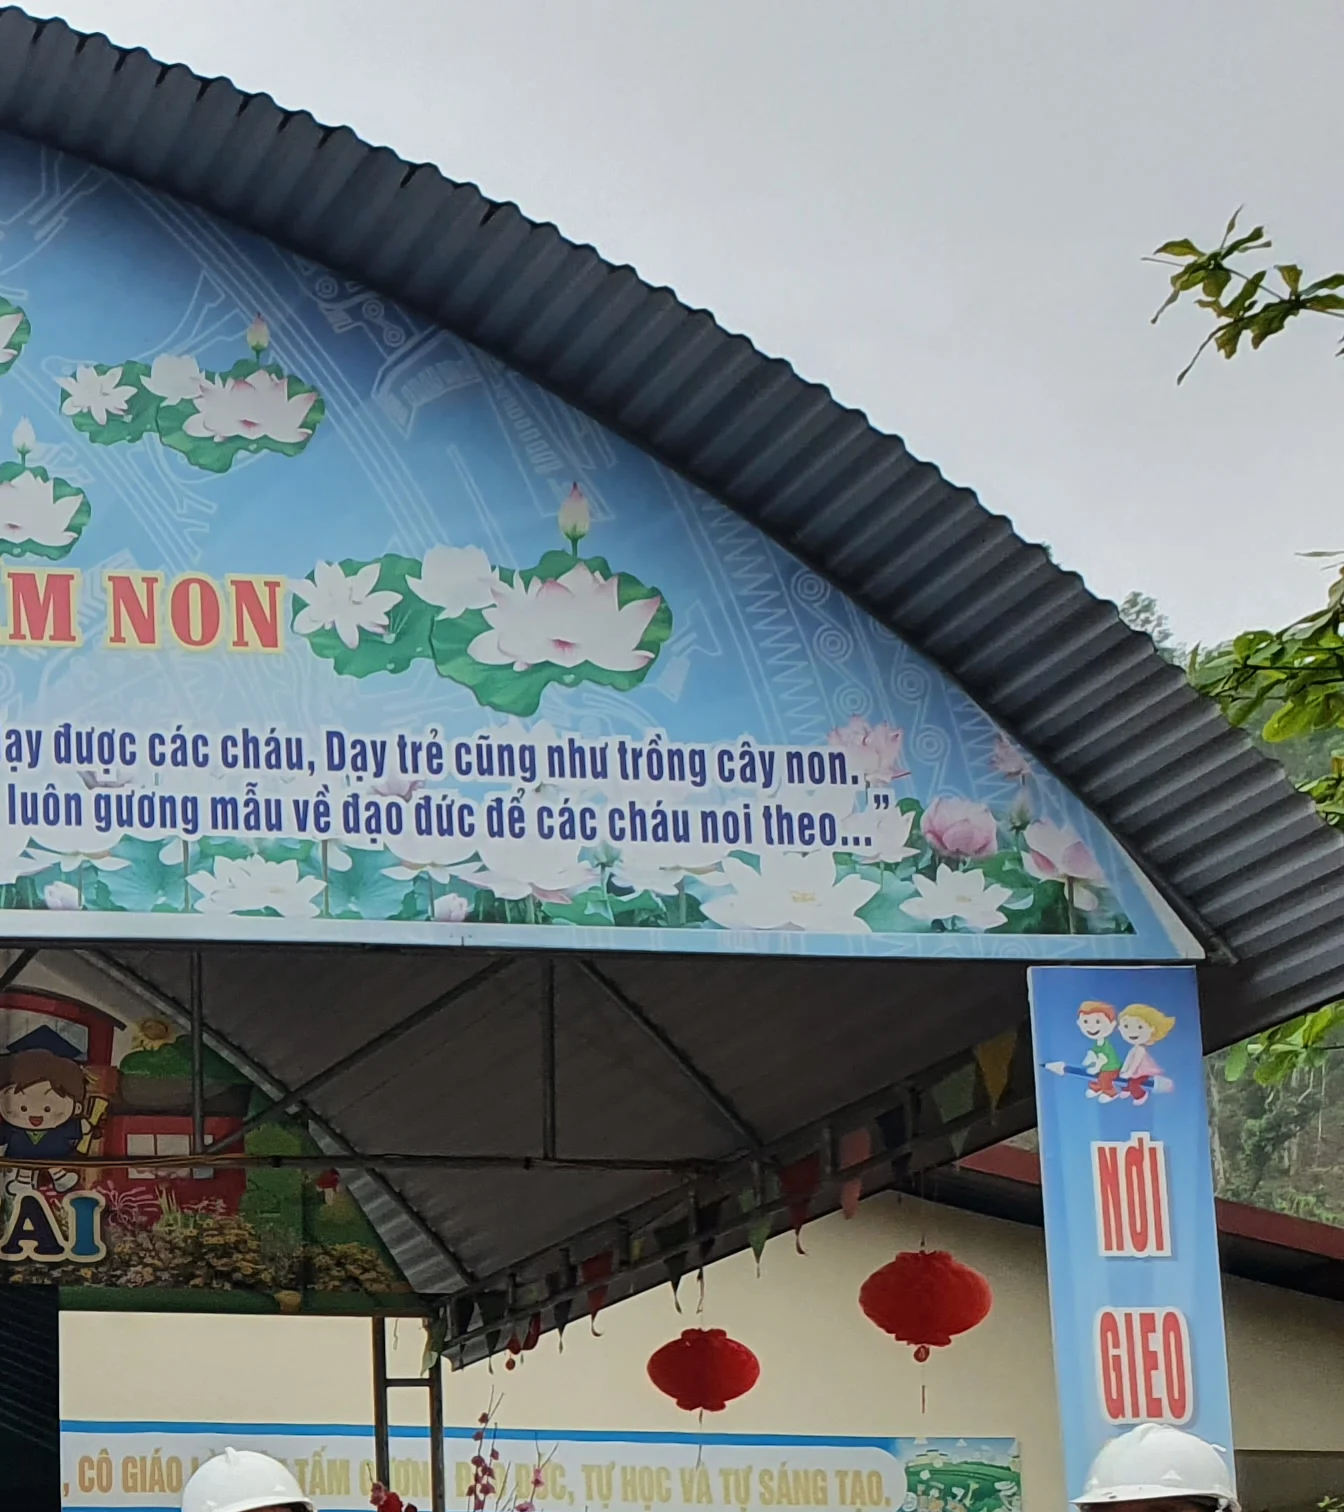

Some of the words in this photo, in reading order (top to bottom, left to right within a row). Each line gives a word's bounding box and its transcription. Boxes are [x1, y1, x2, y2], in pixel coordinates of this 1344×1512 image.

[109, 576, 280, 649] NON
[54, 722, 137, 766] được
[149, 724, 210, 768] các
[222, 727, 315, 773] cháu,
[326, 730, 387, 779] Dạy
[398, 734, 444, 775] trẻ
[455, 735, 537, 783] cũng
[547, 737, 609, 780] như
[618, 733, 707, 788] trồng
[719, 740, 776, 789] cây
[787, 750, 860, 785] non.
[8, 783, 83, 827] luôn
[94, 791, 199, 835] gương
[211, 782, 283, 832] mẫu
[294, 791, 331, 834] về
[343, 792, 403, 844] đạo
[415, 794, 475, 838] đức
[487, 796, 526, 839] để
[538, 805, 597, 841] các
[608, 800, 691, 843] cháu
[701, 803, 753, 845] noi
[1097, 1136, 1166, 1253] NƠI
[1100, 1311, 1188, 1420] GIEO
[78, 1448, 112, 1494] CÔ
[121, 1448, 183, 1495] GIÁO
[580, 1461, 618, 1510] TỰ
[620, 1465, 674, 1512] HỌC
[679, 1462, 714, 1505] VÀ
[758, 1461, 828, 1507] SÁNG
